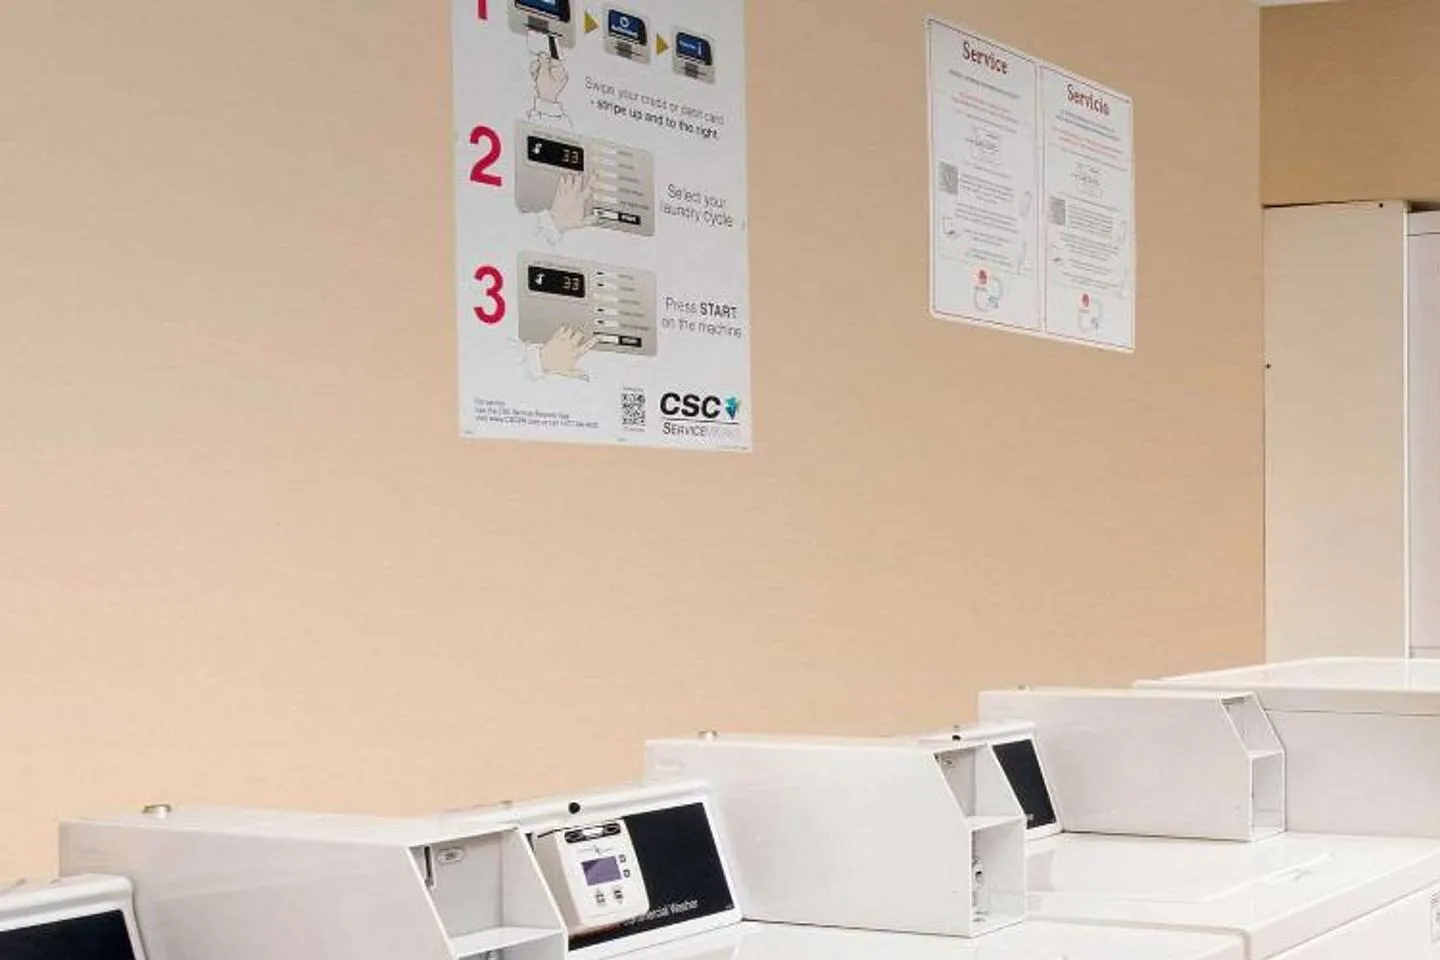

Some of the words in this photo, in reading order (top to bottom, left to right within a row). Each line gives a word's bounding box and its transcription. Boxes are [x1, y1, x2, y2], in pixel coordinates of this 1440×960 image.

[962, 41, 1009, 75] Service
[1066, 84, 1110, 116] Servicio
[470, 125, 502, 187] 2
[473, 265, 506, 326] 3
[666, 296, 698, 314] Press
[700, 301, 737, 319] START
[660, 392, 721, 419] CSC
